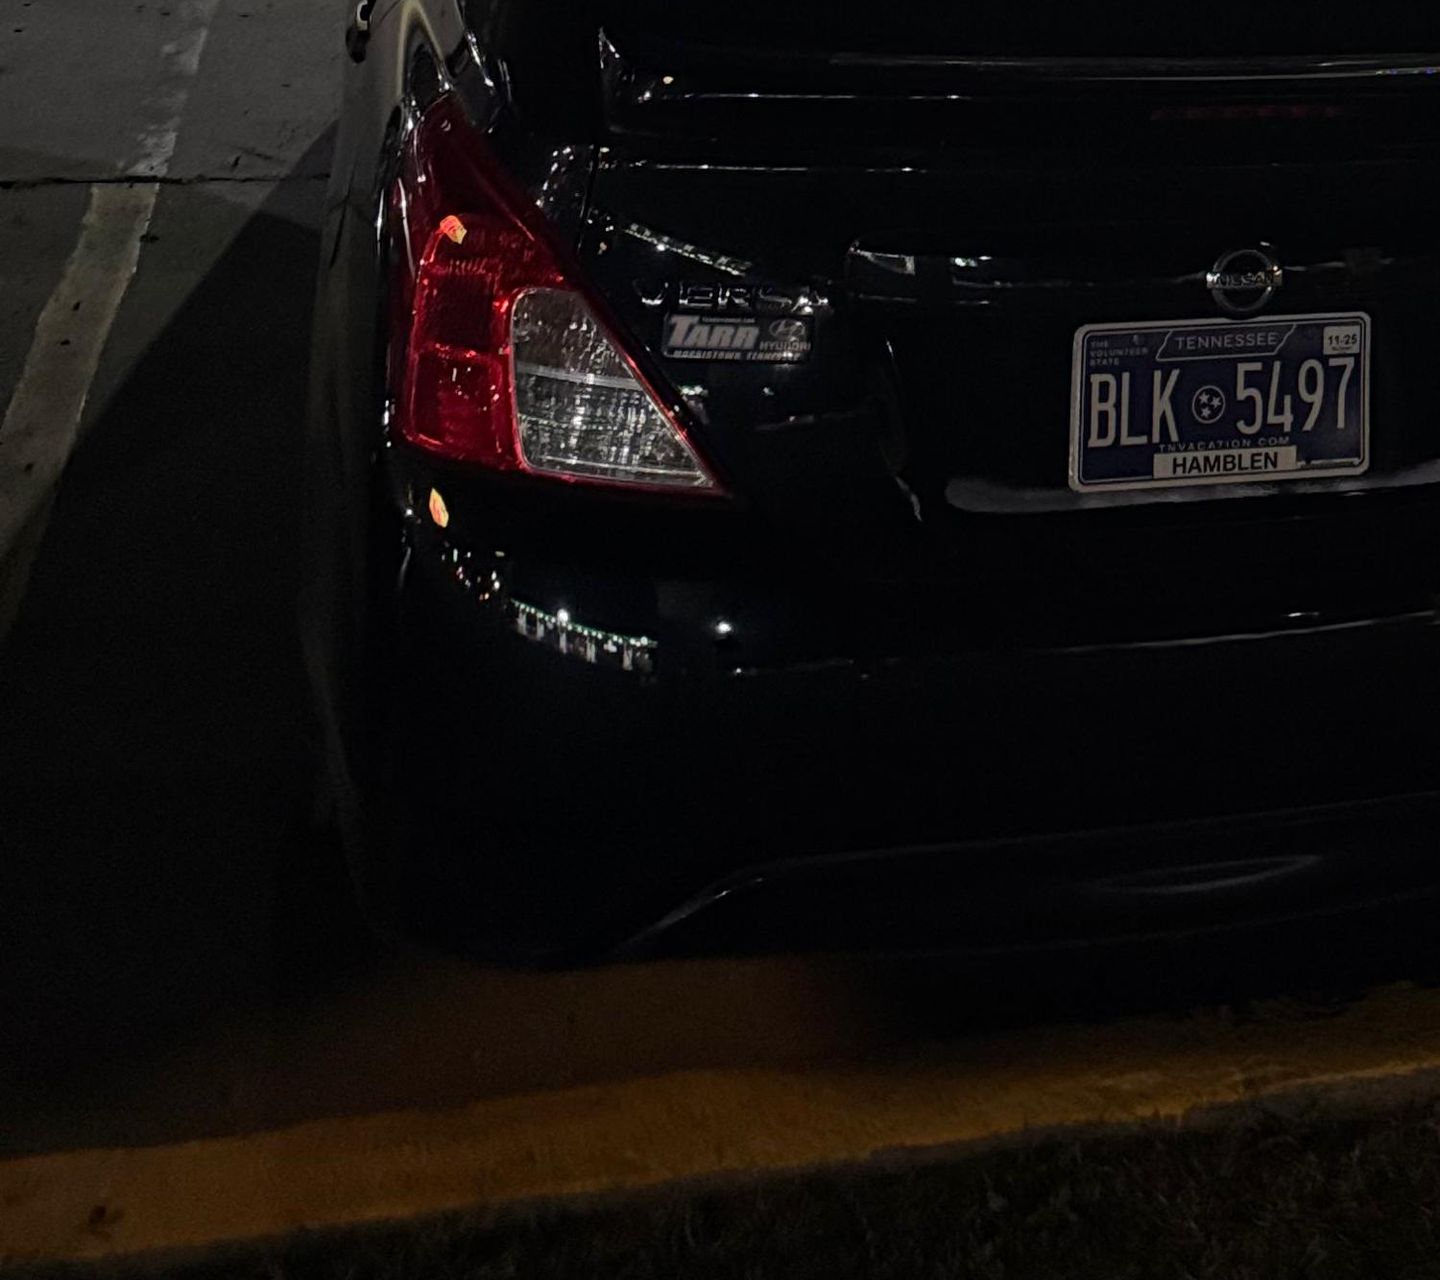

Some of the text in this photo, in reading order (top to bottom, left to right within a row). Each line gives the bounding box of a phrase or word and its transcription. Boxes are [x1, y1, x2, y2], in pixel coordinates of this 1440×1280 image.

[1175, 332, 1280, 351] TENNESSEE
[1088, 357, 1355, 448] BLK 5497
[1171, 452, 1279, 475] HAMBLEN
